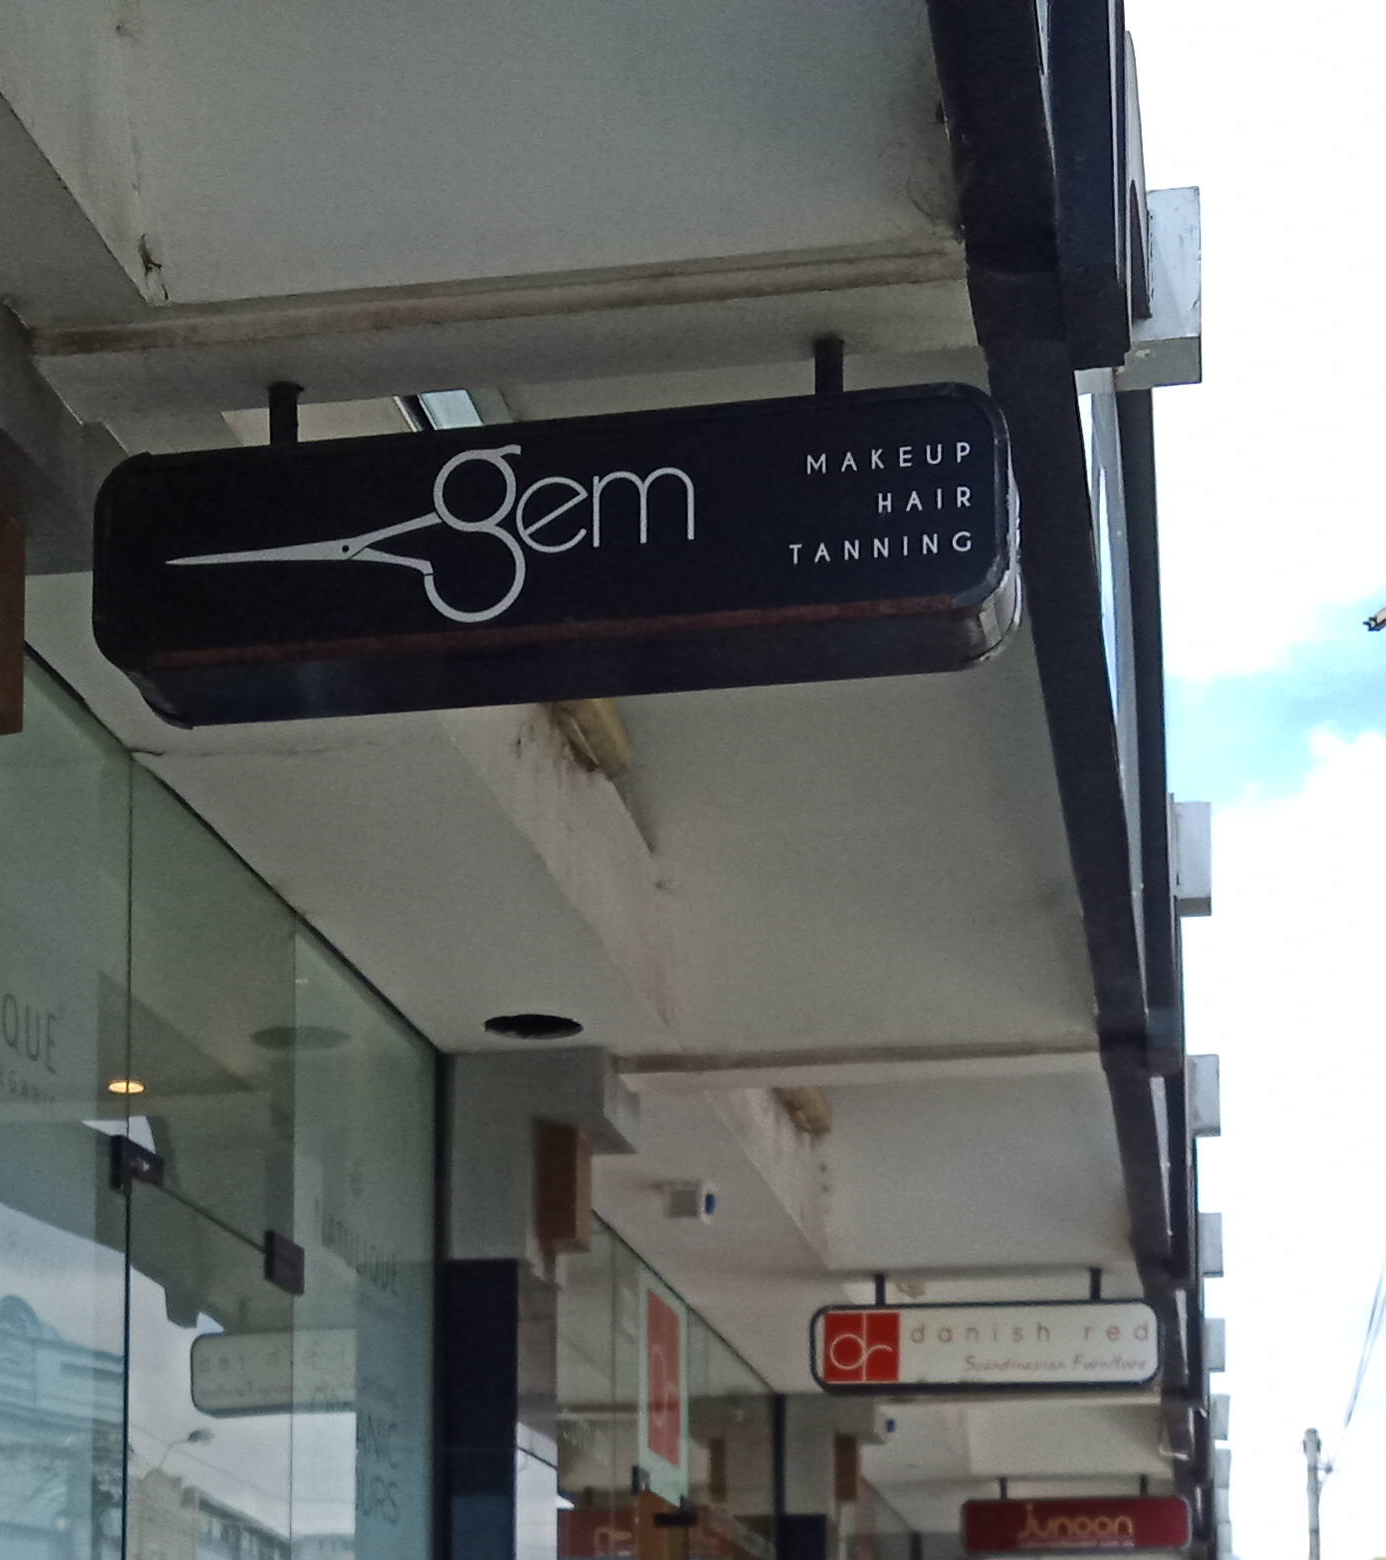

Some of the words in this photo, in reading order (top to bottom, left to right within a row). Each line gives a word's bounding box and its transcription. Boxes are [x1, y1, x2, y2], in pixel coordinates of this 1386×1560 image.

[806, 441, 971, 475] MAKEUP
[877, 486, 971, 514] HAIR
[425, 444, 695, 623] gem
[788, 530, 972, 565] TANNING
[910, 1321, 1051, 1344] danish
[1084, 1320, 1150, 1343] red
